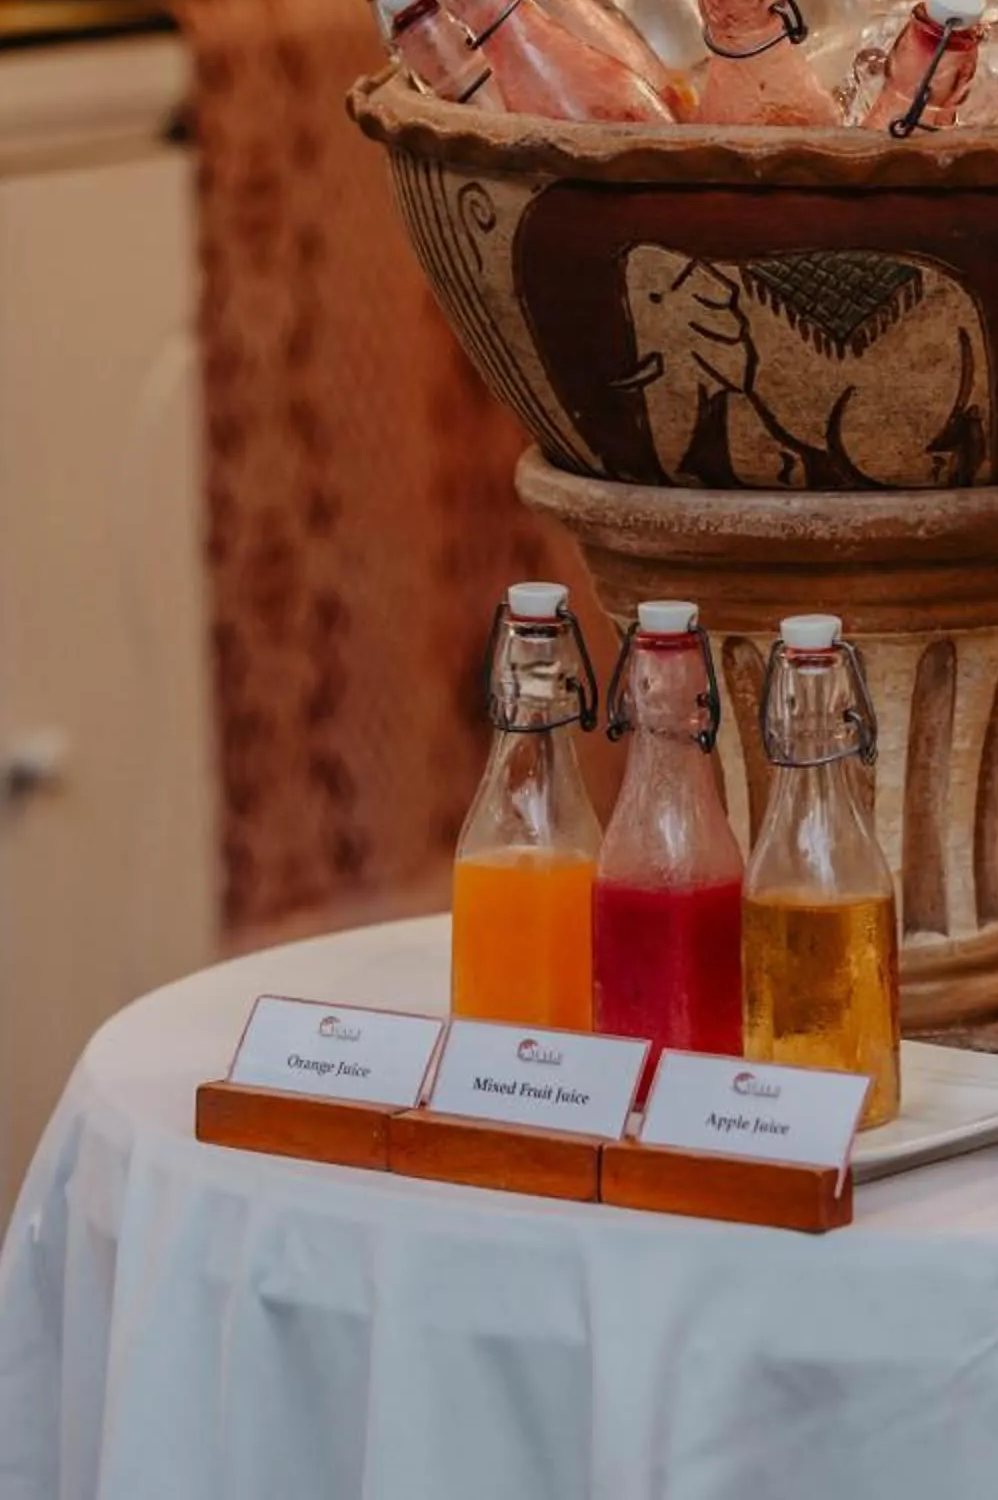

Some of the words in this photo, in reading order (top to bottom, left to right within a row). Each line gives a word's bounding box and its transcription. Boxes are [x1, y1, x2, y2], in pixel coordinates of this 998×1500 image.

[287, 1054, 334, 1075] Orange
[336, 1061, 371, 1077] Juice
[473, 1077, 517, 1096] Mixed
[519, 1083, 553, 1100] Fruit
[555, 1088, 590, 1105] Juice
[705, 1113, 750, 1133] Apple
[753, 1117, 790, 1135] Juice
